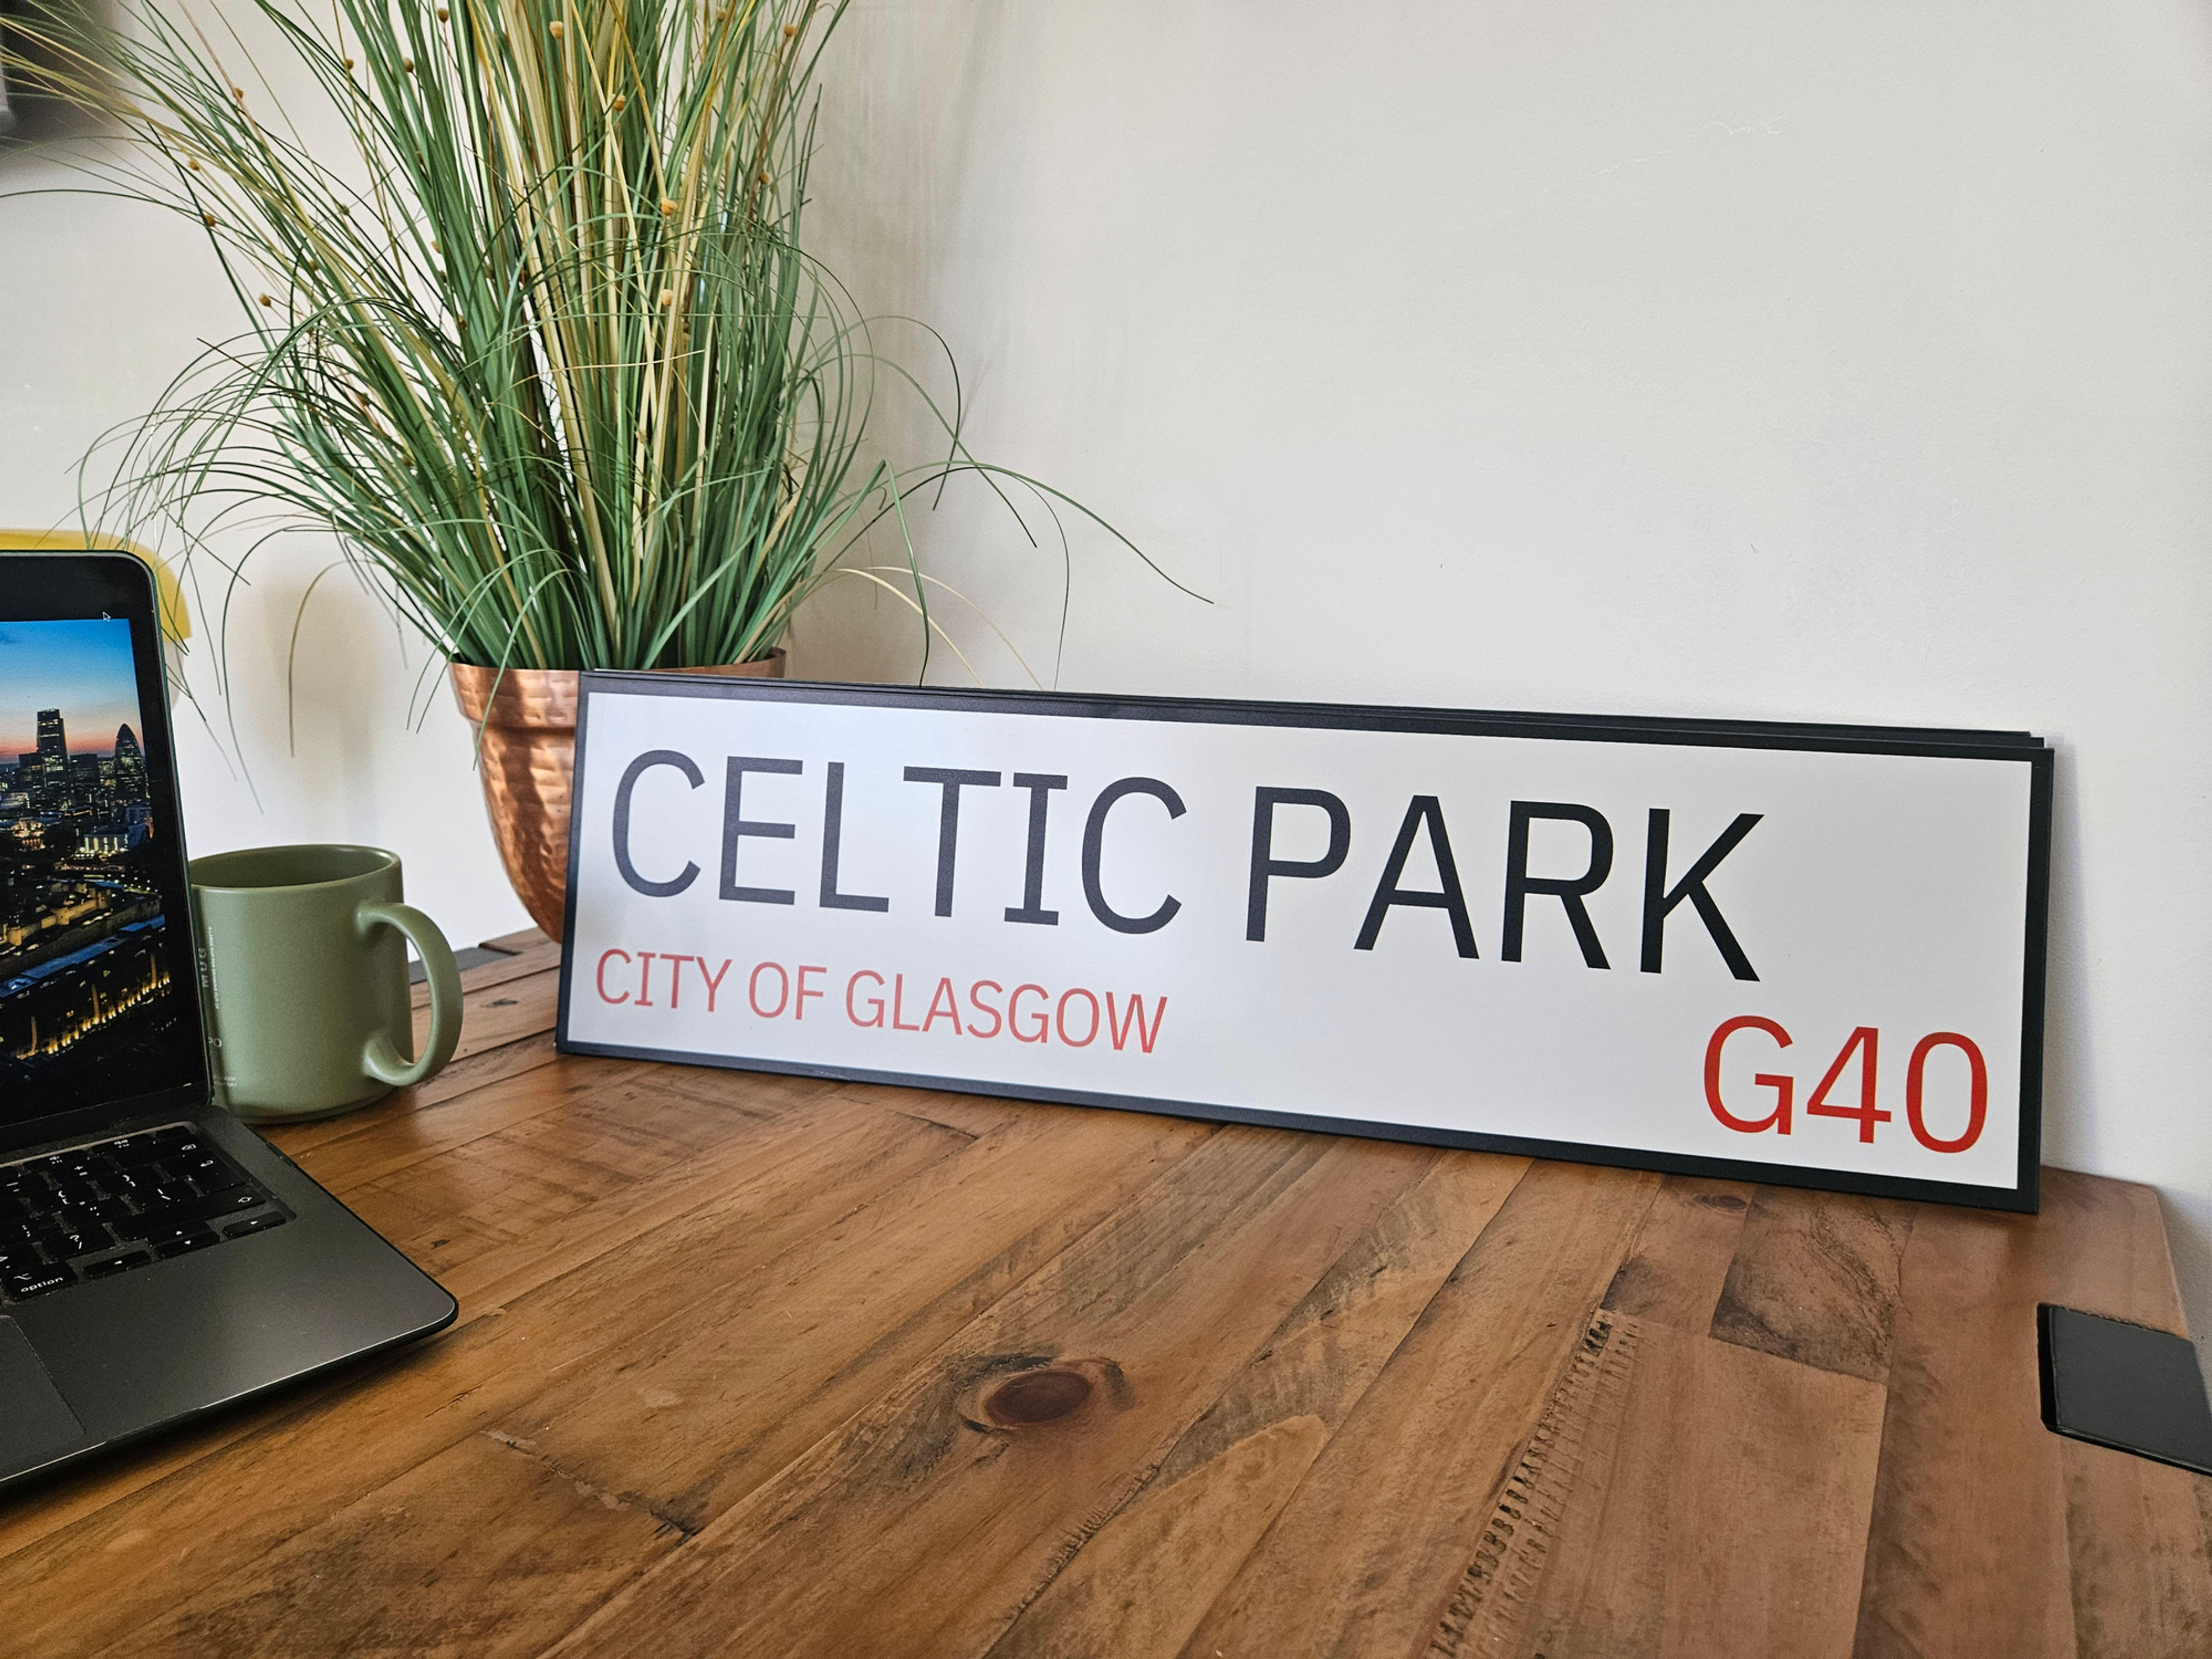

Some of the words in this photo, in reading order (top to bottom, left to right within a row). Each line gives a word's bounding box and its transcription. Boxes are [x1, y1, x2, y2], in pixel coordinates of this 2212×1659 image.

[613, 749, 1187, 934] CELTIC
[1246, 786, 1765, 982] PARK
[198, 947, 209, 988] MUG
[597, 949, 732, 1011] CITY
[749, 962, 826, 1020] OF
[846, 970, 1167, 1053] GLASGOW
[1704, 1015, 1988, 1154] G40
[21, 1277, 63, 1293] option
